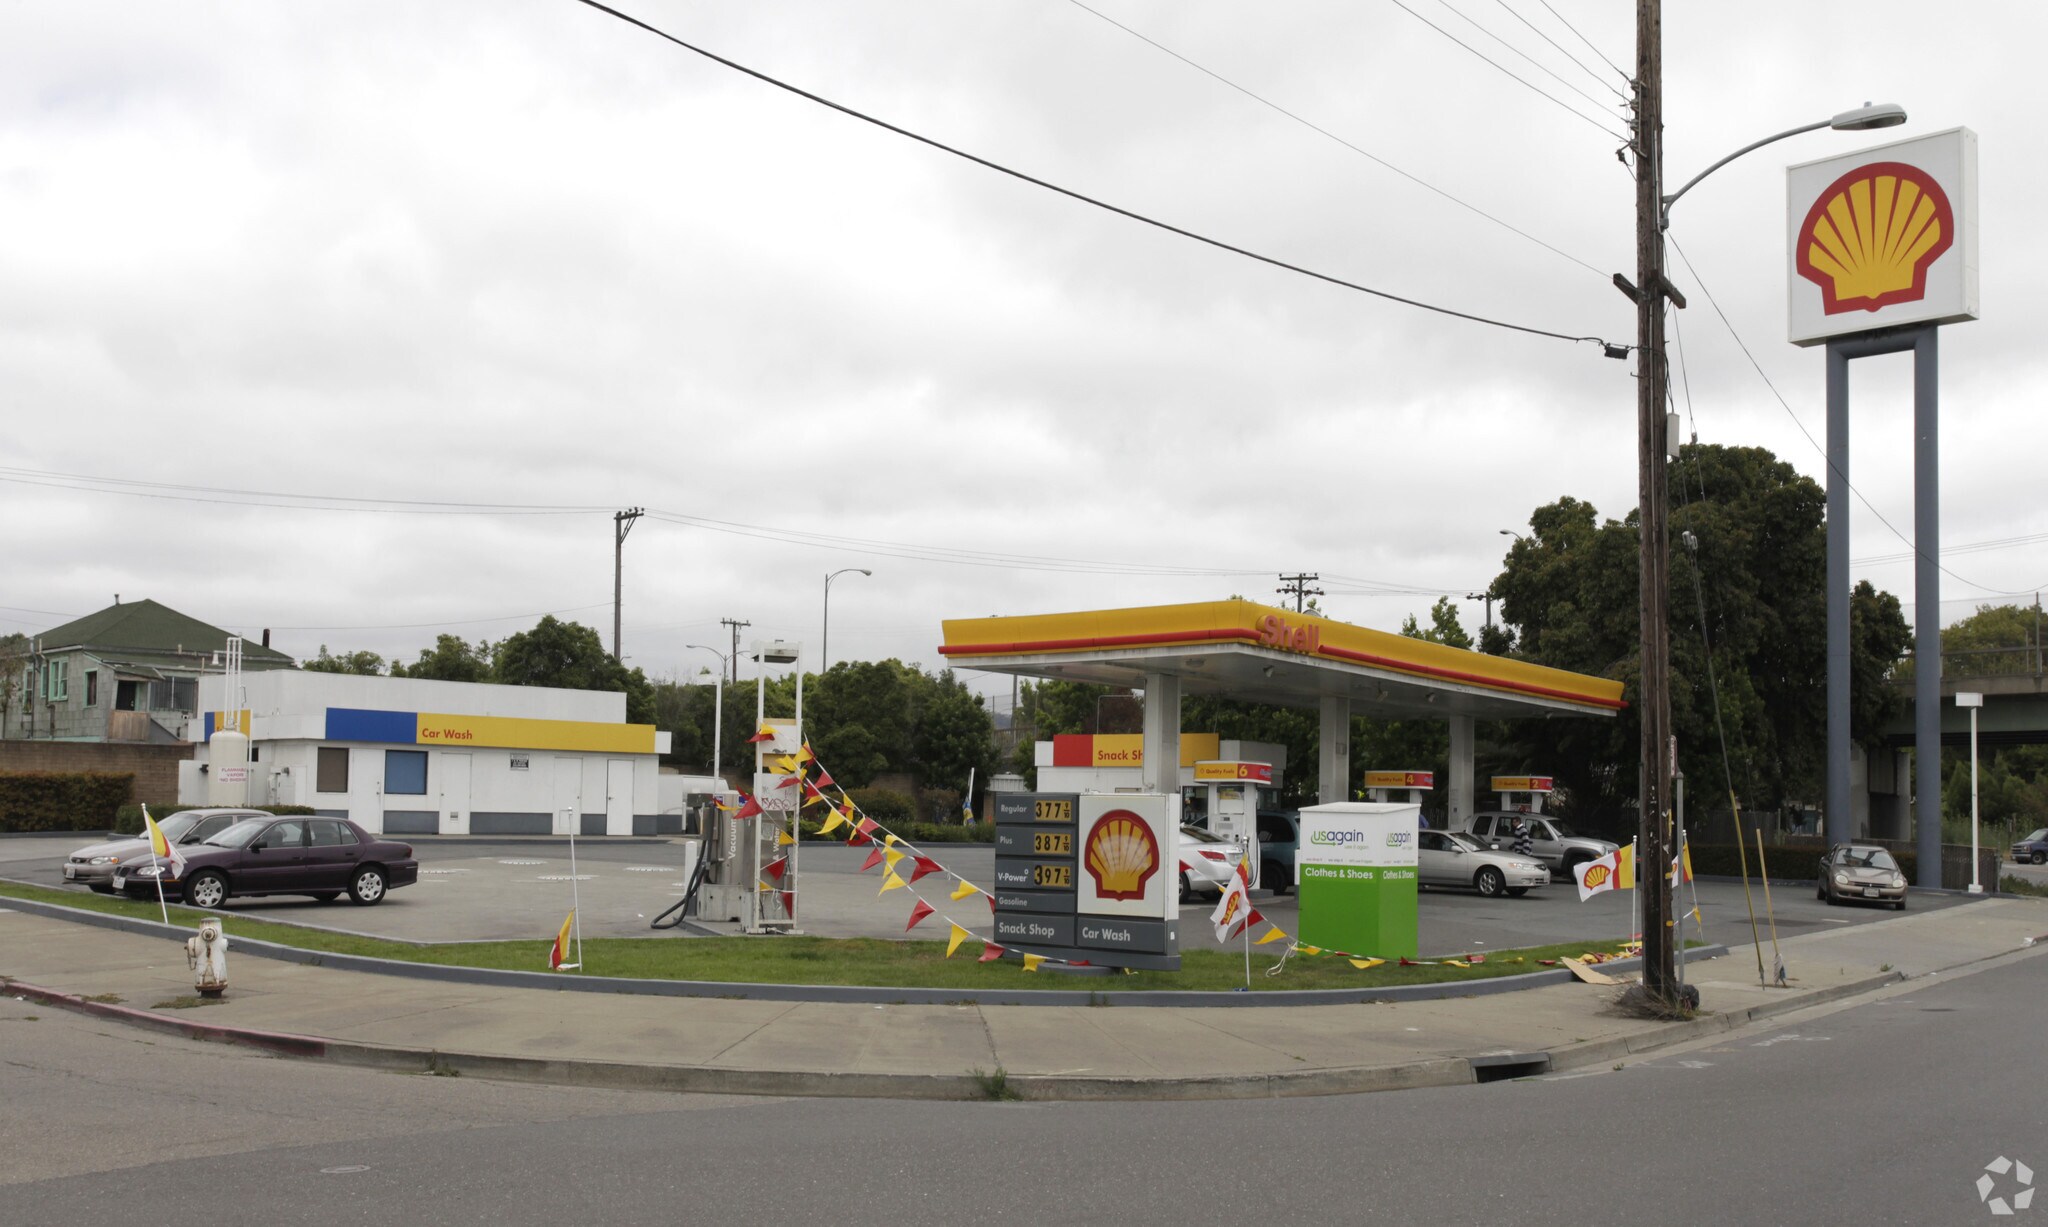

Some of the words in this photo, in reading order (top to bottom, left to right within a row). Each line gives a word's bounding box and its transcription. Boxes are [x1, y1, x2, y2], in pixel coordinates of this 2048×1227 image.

[1262, 614, 1319, 652] Shell
[421, 728, 441, 738] Car
[443, 729, 473, 740] Wash
[1097, 749, 1129, 761] Snack
[1239, 765, 1248, 777] 6
[1406, 774, 1415, 784] 4
[1532, 779, 1539, 788] 2
[1000, 804, 1027, 815] Regular
[1035, 800, 1061, 818] 377
[727, 818, 737, 860] Vacuum
[1000, 836, 1013, 845] Plus
[1035, 834, 1061, 851] 387
[1313, 829, 1364, 845] usagain
[997, 872, 1028, 882] V-Power
[1034, 864, 1061, 885] 397
[1305, 867, 1337, 878] Clothes
[1339, 869, 1345, 878] &
[1347, 869, 1373, 880] Shoes
[1382, 870, 1398, 880] Clothes
[1401, 870, 1415, 880] Shoes
[998, 896, 1028, 906] Gasoline
[998, 921, 1026, 935] Snack
[1028, 923, 1055, 938] Shop
[1082, 926, 1100, 939] Car
[1101, 928, 1131, 942] Wash
